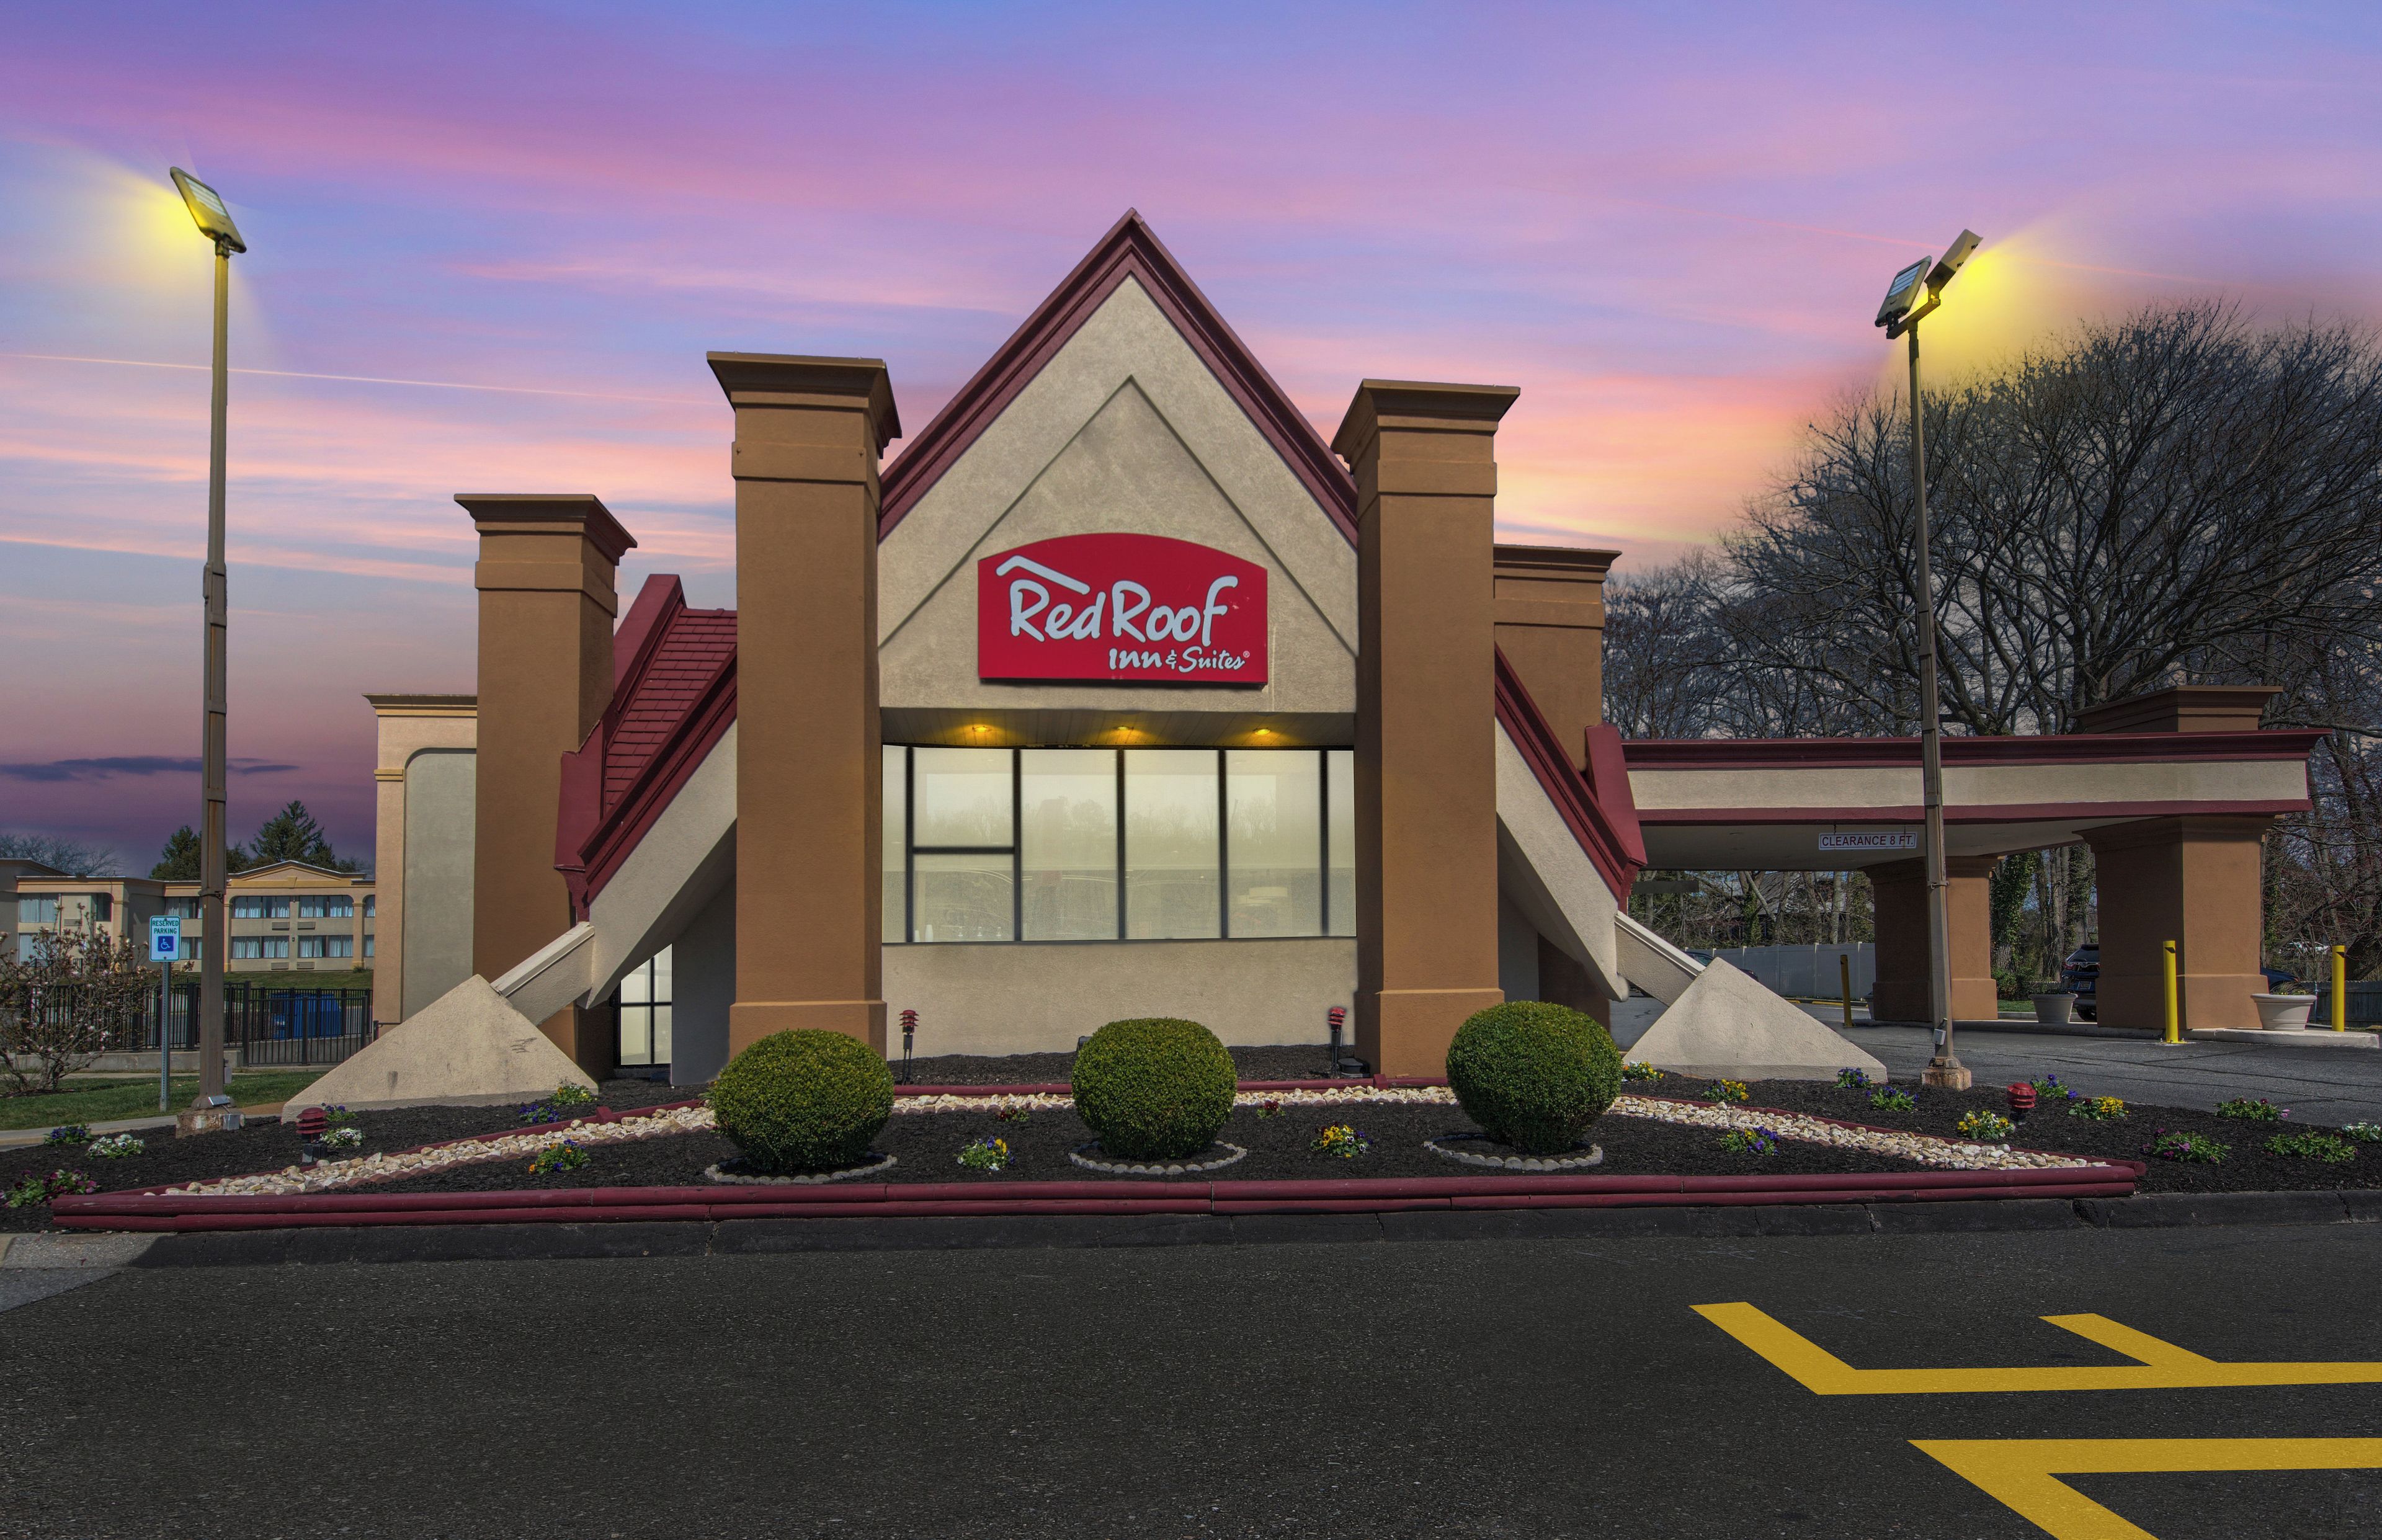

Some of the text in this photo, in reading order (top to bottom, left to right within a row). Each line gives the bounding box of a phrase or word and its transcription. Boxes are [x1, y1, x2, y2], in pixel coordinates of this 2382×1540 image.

[1010, 576, 1238, 646] Red Roof
[1109, 648, 1162, 670] Inn
[1165, 649, 1177, 669] &
[1822, 835, 1914, 846] CLEARANCE 8 FT.
